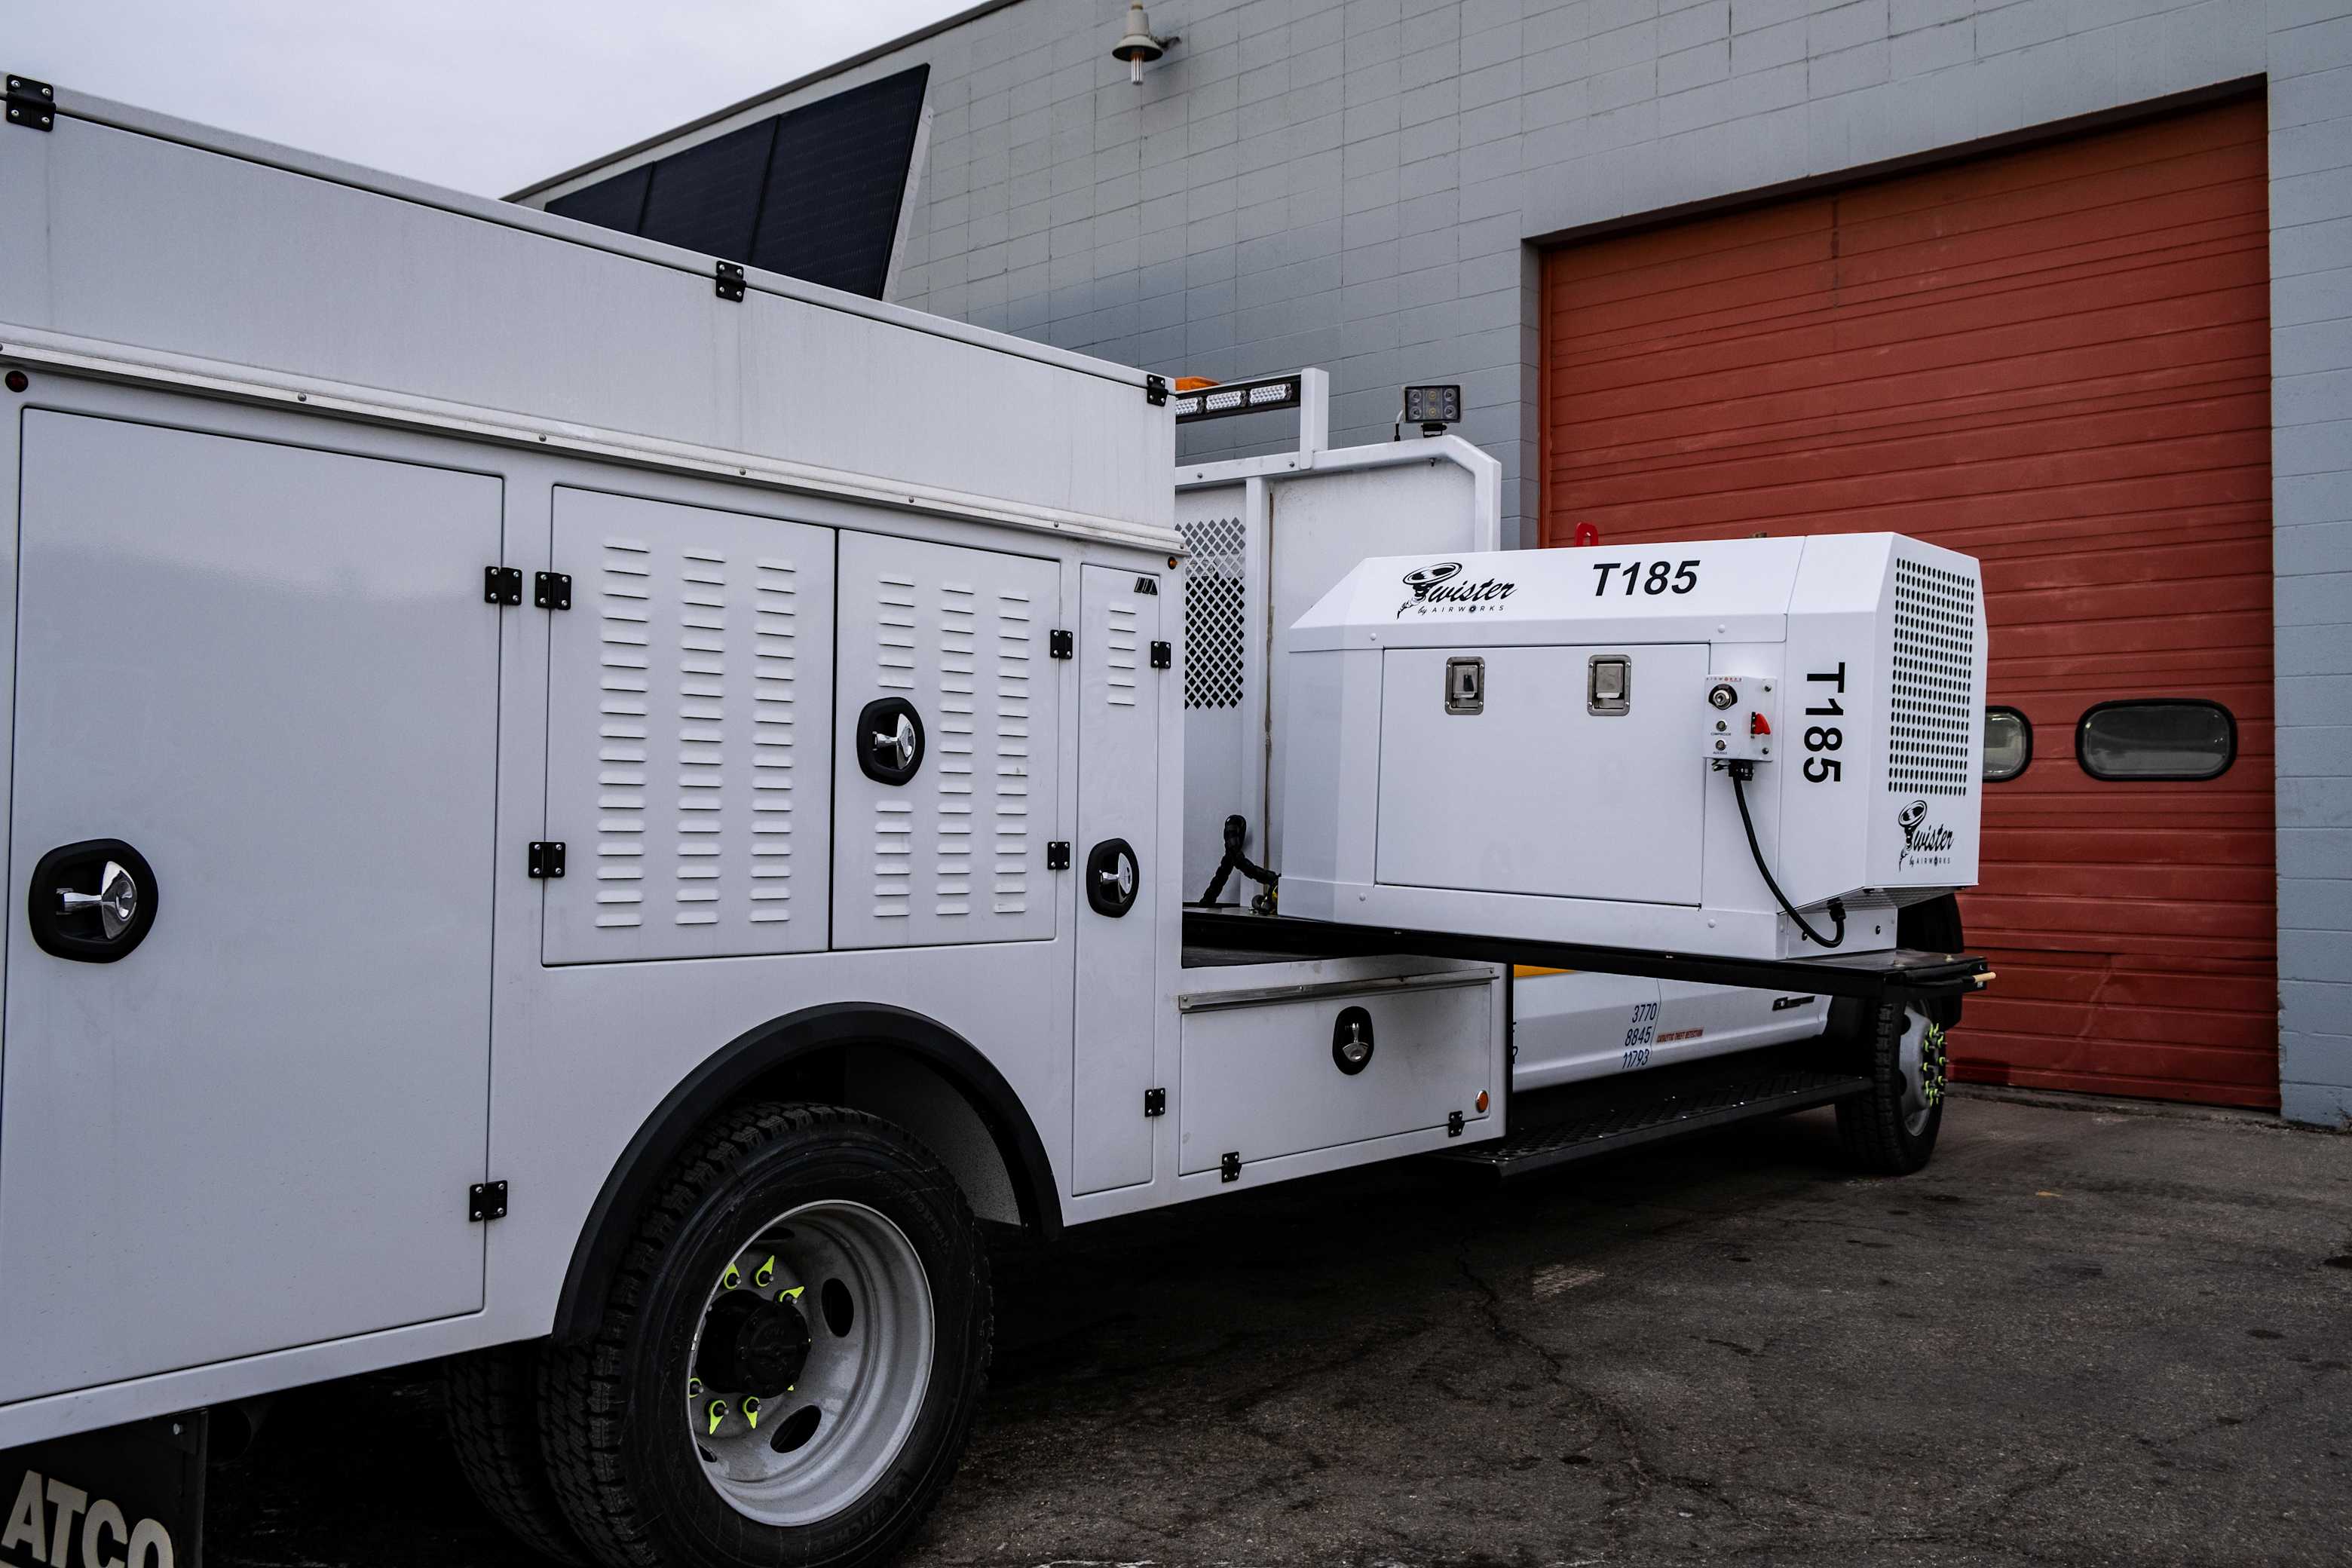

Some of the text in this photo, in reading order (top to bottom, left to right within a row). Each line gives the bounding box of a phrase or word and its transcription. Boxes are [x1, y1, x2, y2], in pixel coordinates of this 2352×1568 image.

[1594, 560, 1701, 596] T185
[1418, 605, 1427, 615] by
[1803, 662, 1845, 782] T185
[1632, 1003, 1657, 1023] 3770
[1625, 1026, 1652, 1046] 8845
[1622, 1049, 1649, 1069] 11793
